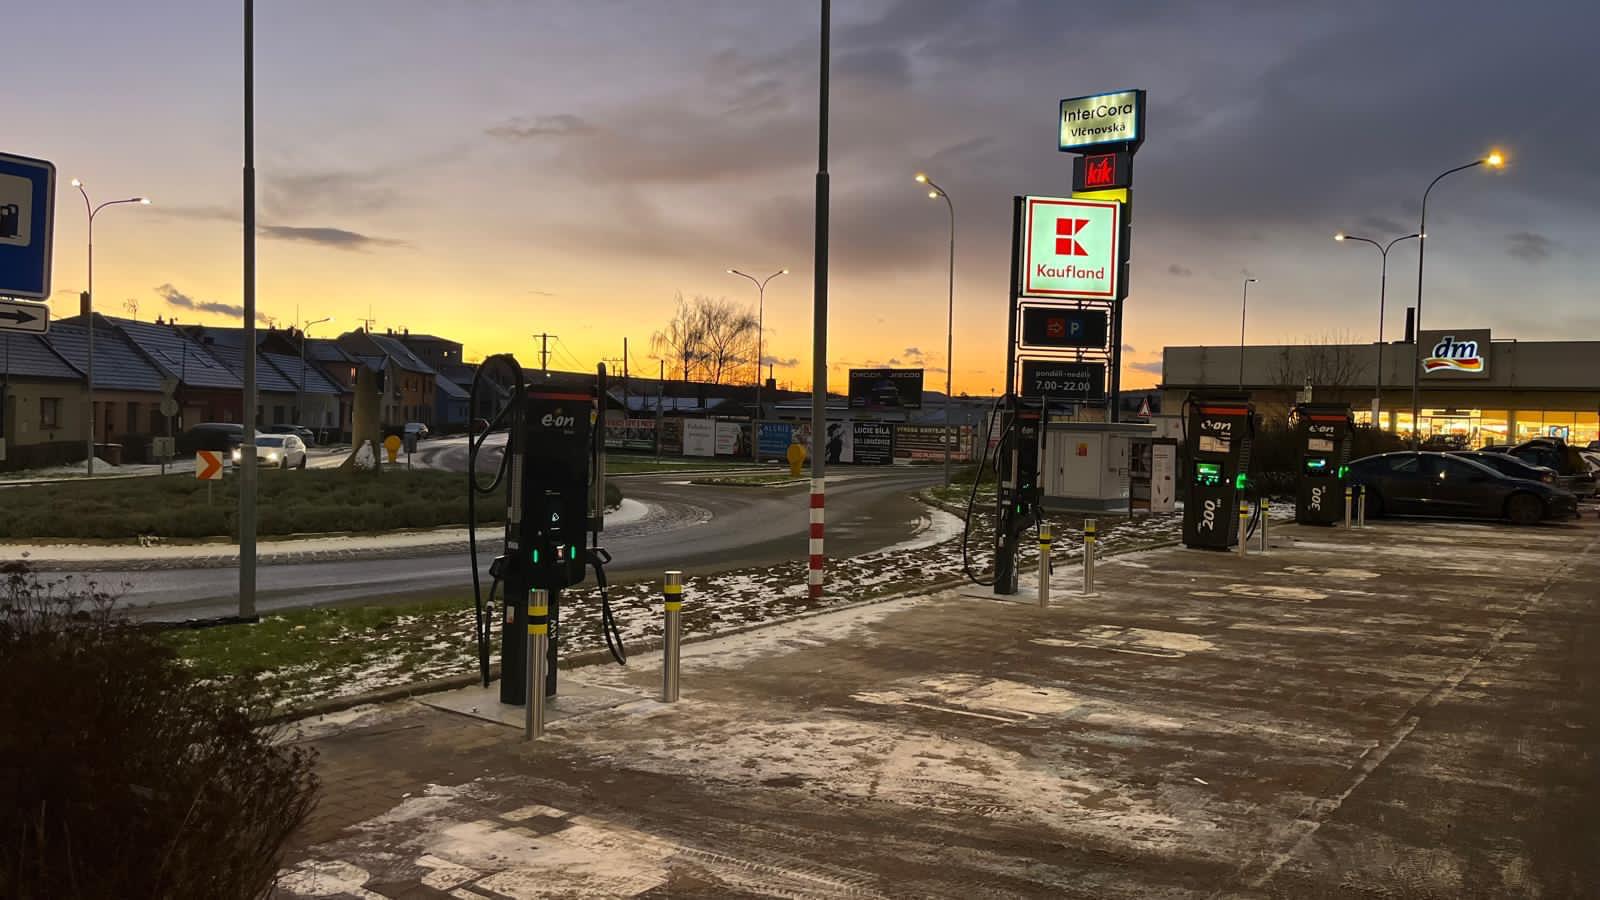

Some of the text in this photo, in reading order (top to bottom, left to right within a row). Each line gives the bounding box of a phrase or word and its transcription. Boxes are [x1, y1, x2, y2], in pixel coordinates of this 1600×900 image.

[1064, 104, 1132, 122] InterCora
[1071, 123, 1126, 137] Vlčnovská
[1037, 263, 1105, 280] Kaufland
[1070, 322, 1080, 336] P
[1433, 336, 1478, 359] dm
[1311, 488, 1322, 511] 300
[1202, 500, 1216, 531] 200
